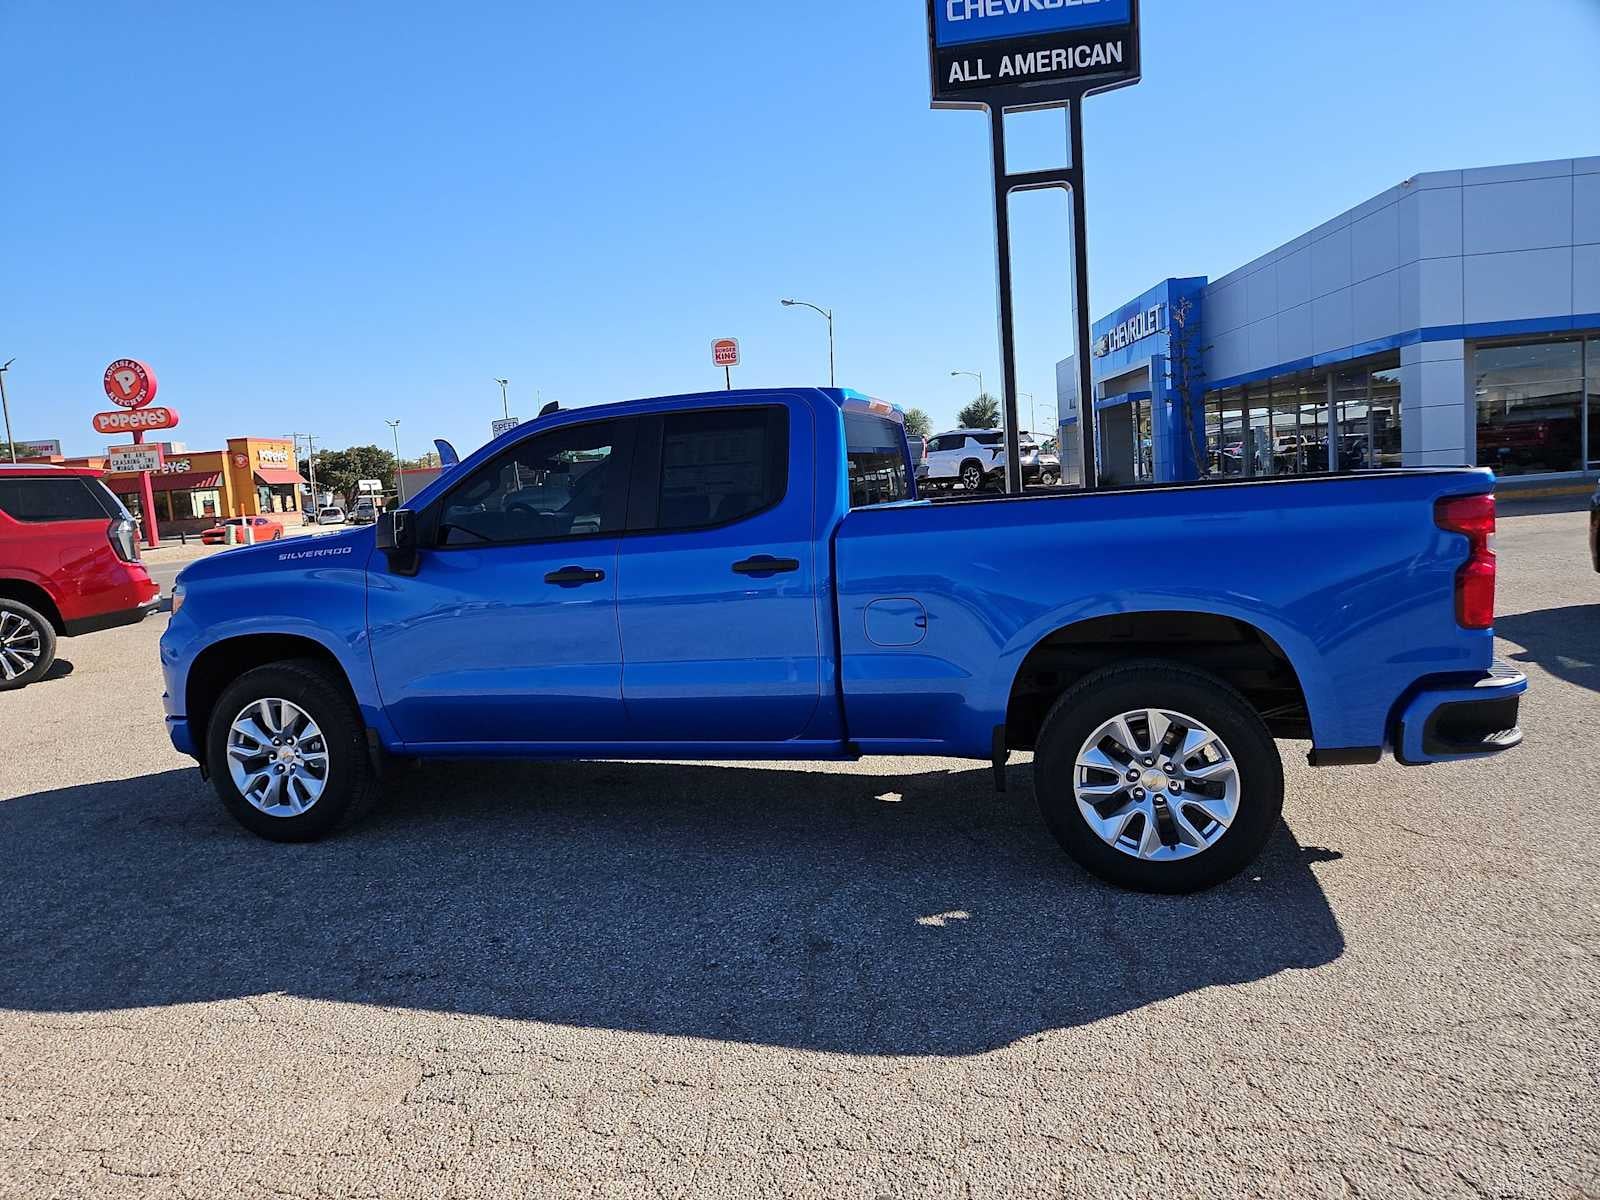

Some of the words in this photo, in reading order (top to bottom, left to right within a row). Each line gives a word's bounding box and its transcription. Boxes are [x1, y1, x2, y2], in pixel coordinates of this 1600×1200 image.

[949, 59, 991, 83] ALL
[999, 41, 1122, 77] AMERICAN
[1108, 304, 1161, 352] CHEVROLET
[715, 352, 737, 360] KING
[105, 360, 145, 381] LOUISIANA
[114, 370, 136, 395] P
[109, 388, 147, 407] KITCHEN
[278, 546, 353, 561] SILVERADO
